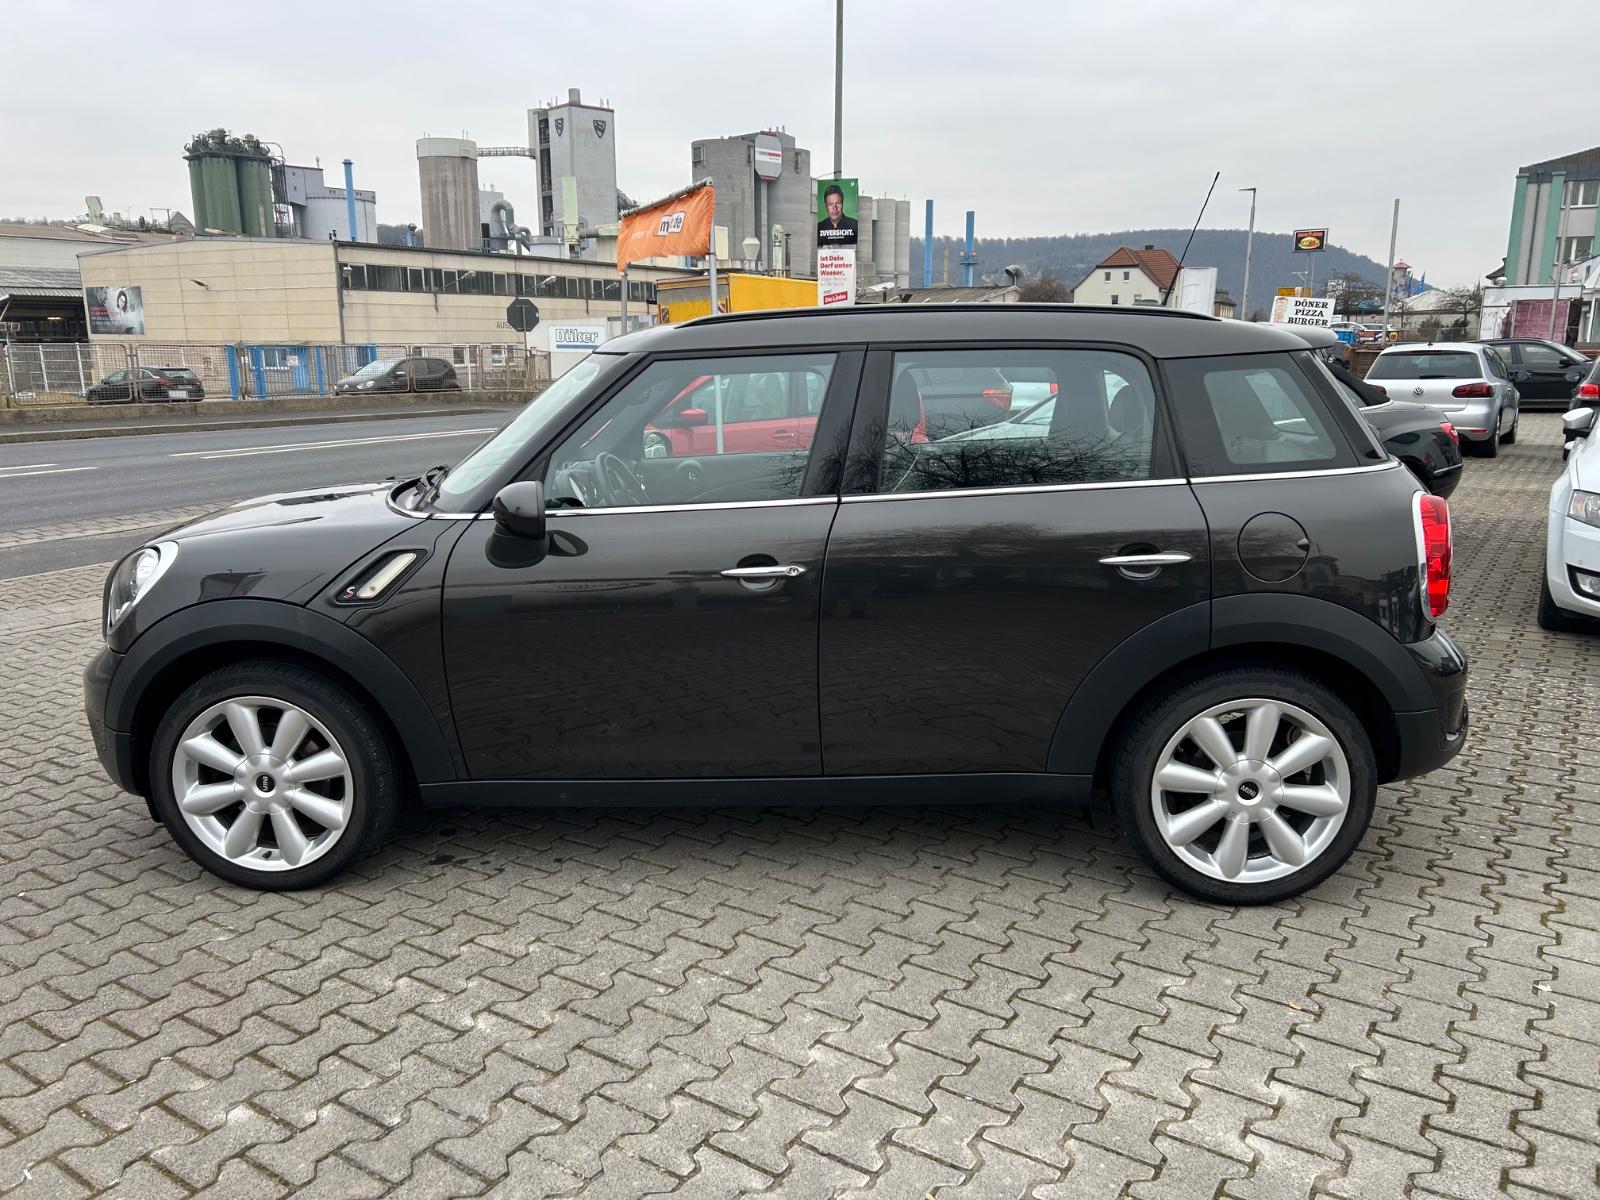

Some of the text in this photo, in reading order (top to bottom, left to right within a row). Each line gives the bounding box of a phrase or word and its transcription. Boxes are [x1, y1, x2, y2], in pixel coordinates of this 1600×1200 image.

[820, 229, 854, 237] ZUVERSICHT.
[1294, 299, 1329, 309] DÖNER
[496, 321, 512, 330] AUS
[1287, 317, 1329, 326] BURGER
[555, 328, 599, 344] Düker
[343, 586, 356, 599] S
[1240, 785, 1258, 797] MINI
